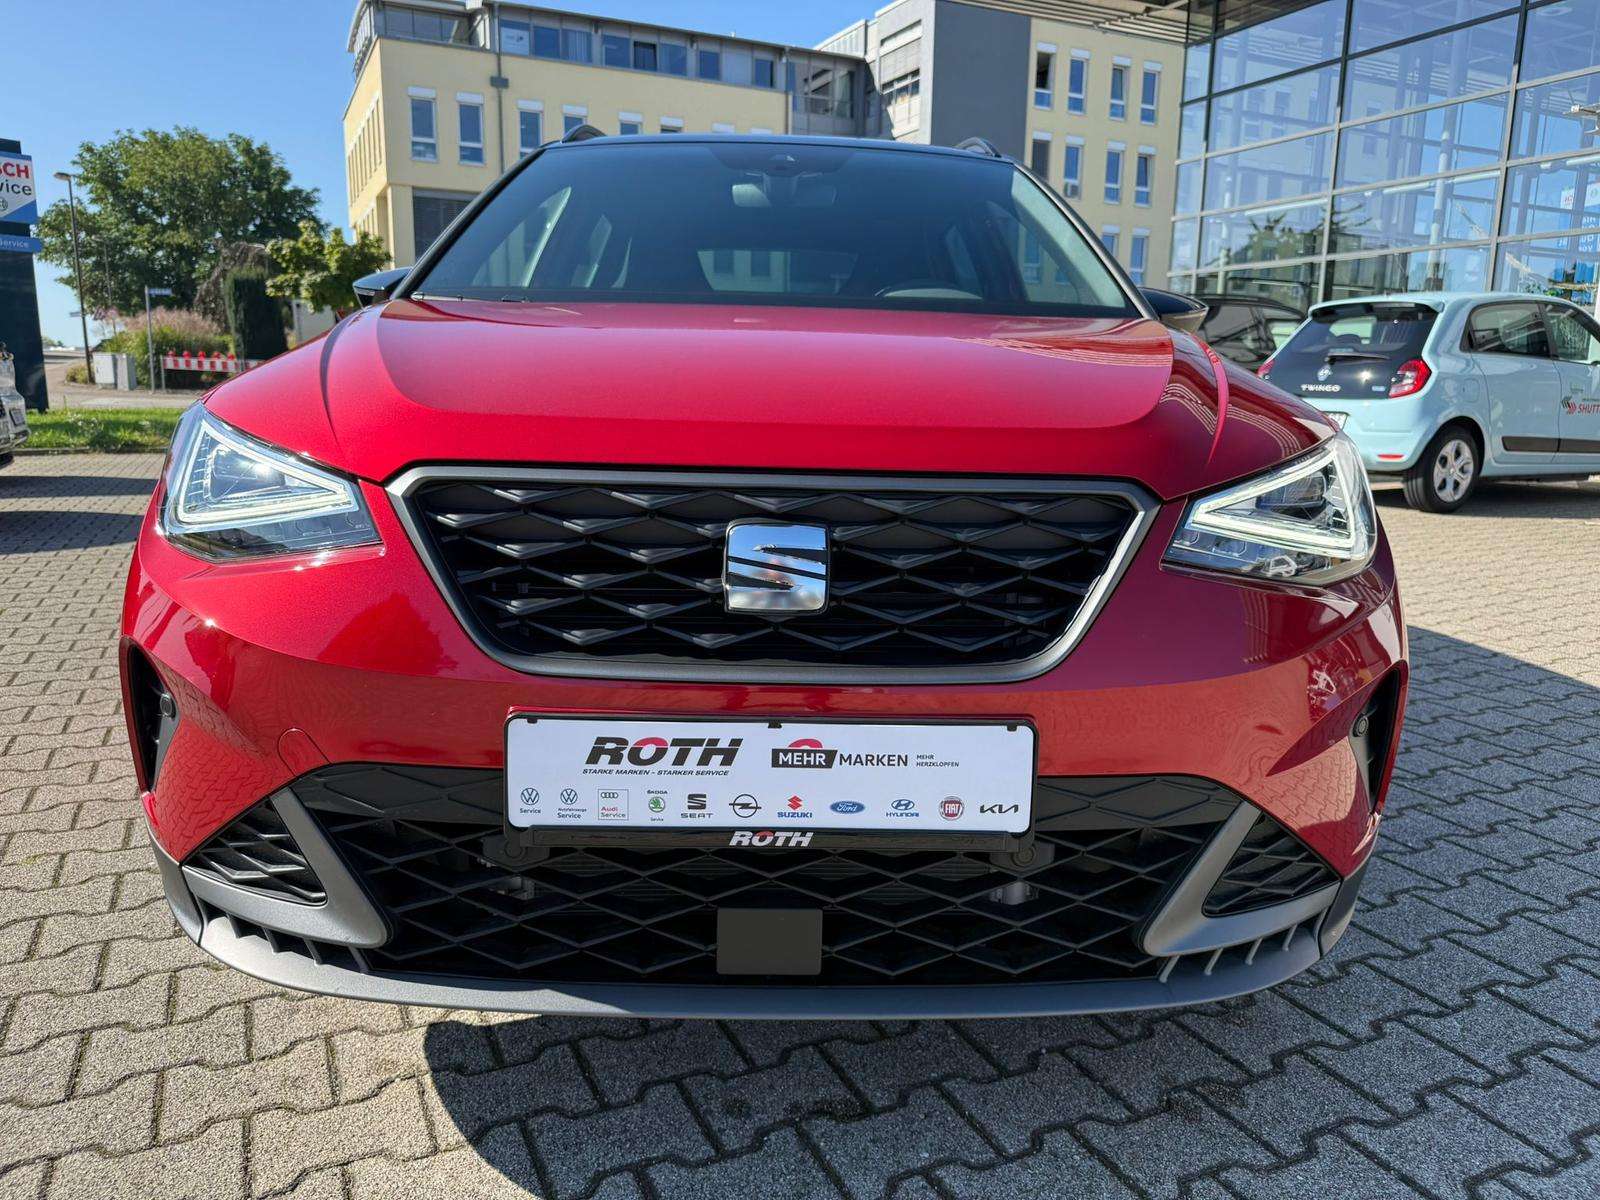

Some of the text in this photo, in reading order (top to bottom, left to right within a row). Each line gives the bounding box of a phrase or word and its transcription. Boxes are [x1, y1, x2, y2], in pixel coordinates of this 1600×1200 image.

[0, 161, 29, 178] CH
[1301, 383, 1341, 392] TWINGO
[585, 736, 743, 767] ROTH
[778, 751, 909, 767] MEHR MARKEN
[777, 811, 813, 819] SUZUKI
[944, 801, 962, 816] FIAT
[979, 803, 1019, 814] KIA
[729, 831, 814, 847] ROTH
